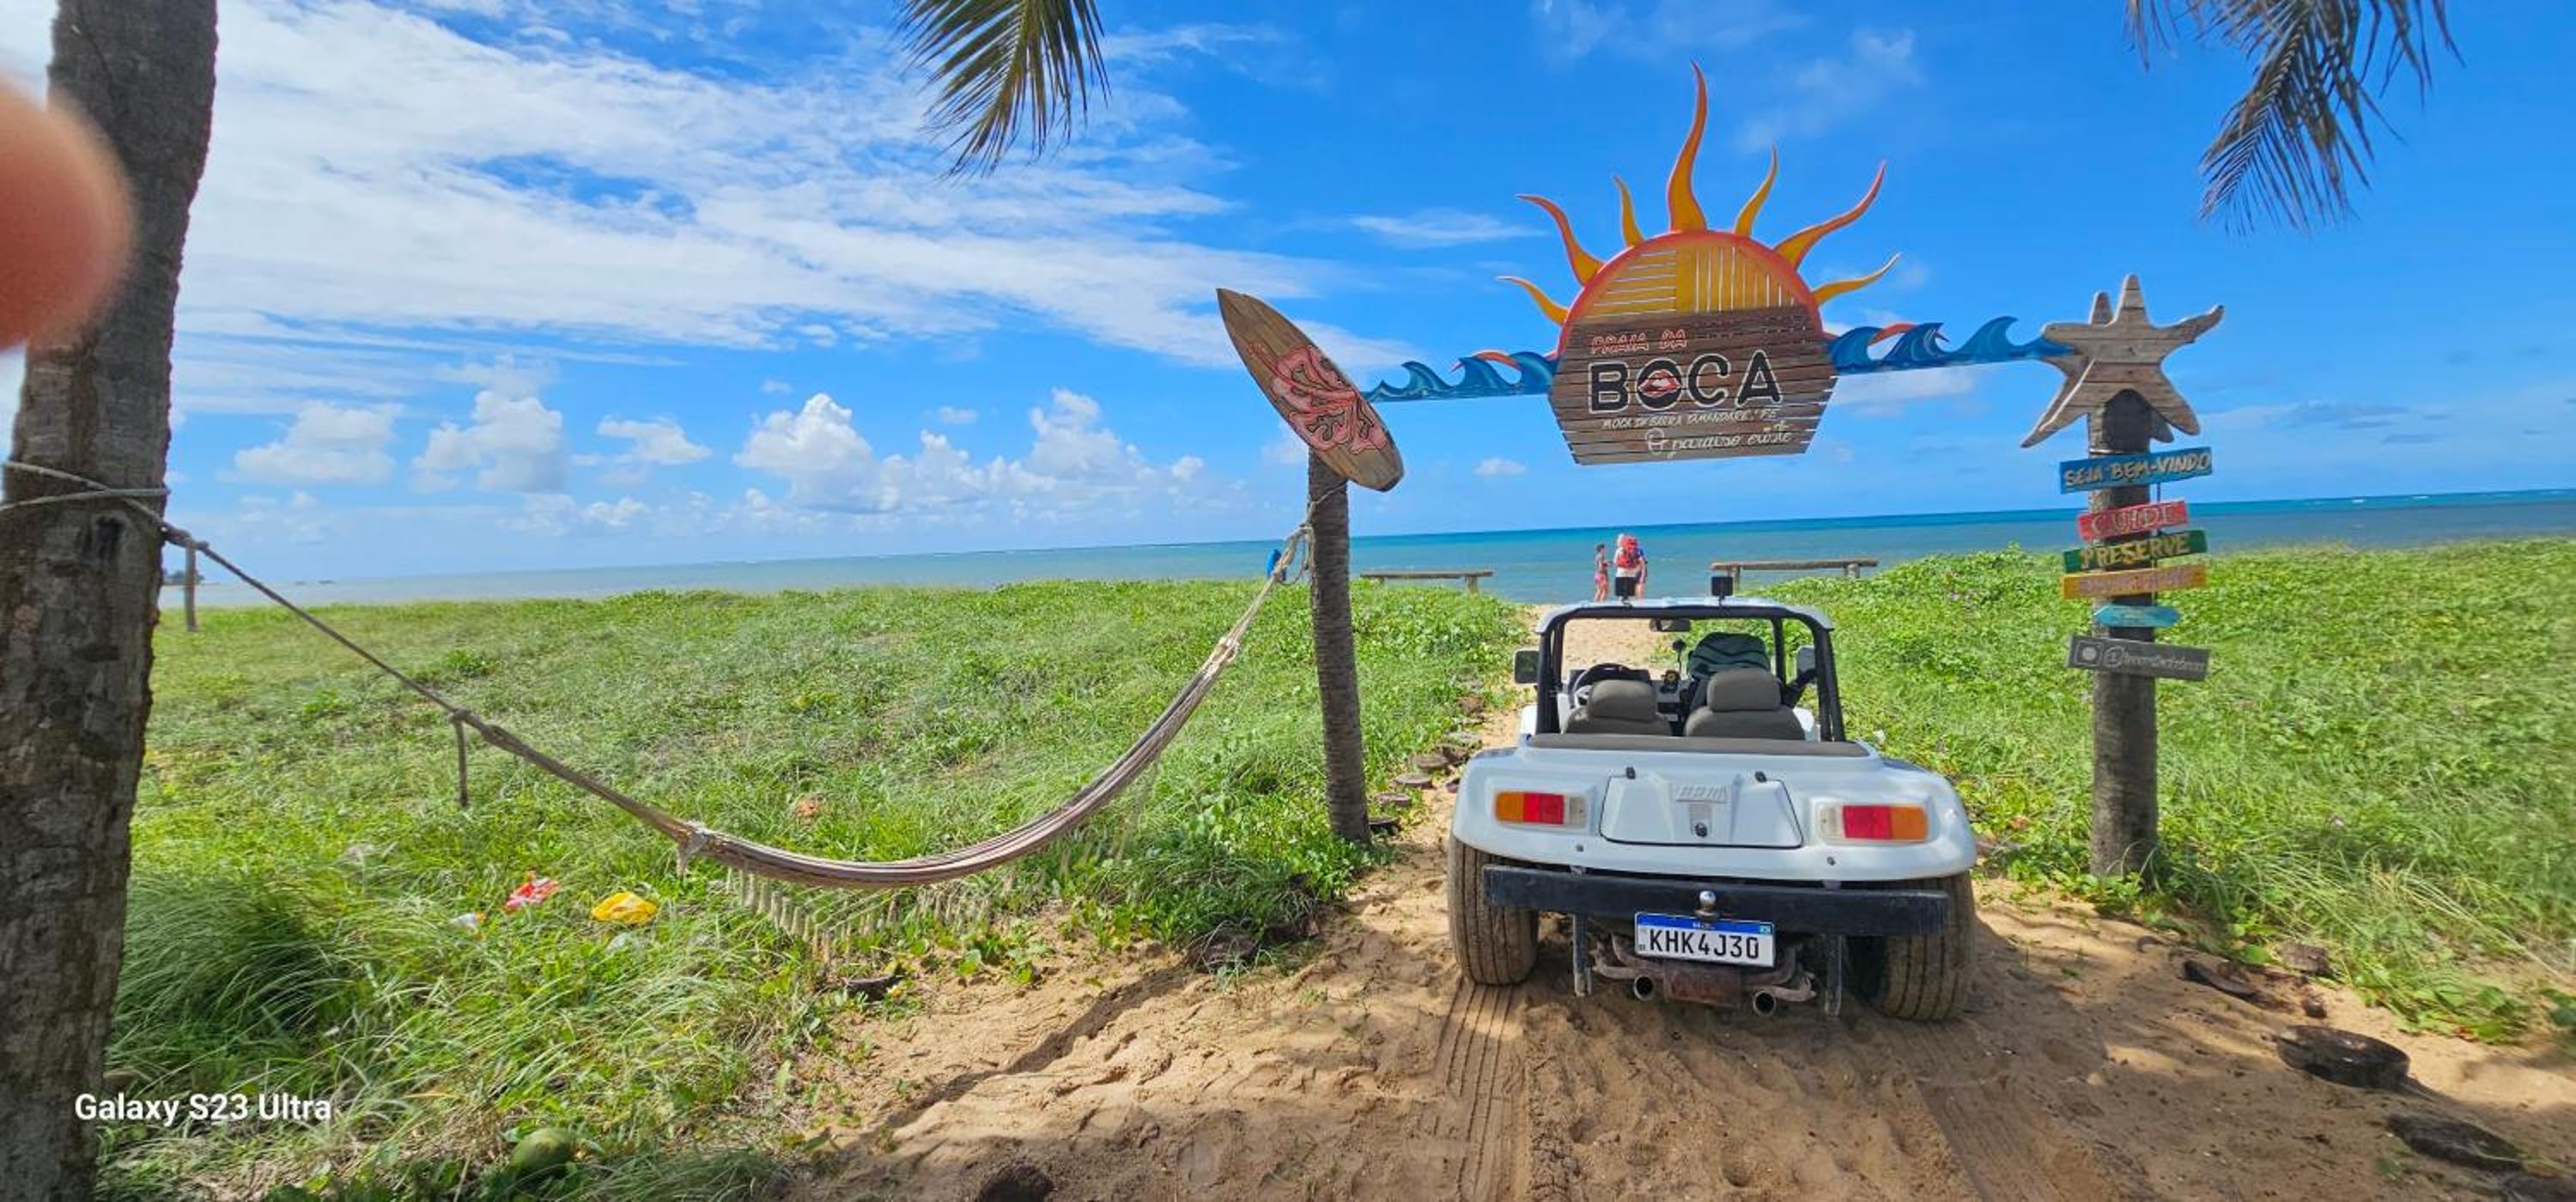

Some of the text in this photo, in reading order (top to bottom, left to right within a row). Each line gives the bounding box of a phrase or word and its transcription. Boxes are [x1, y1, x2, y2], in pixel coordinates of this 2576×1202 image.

[1591, 329, 1687, 355] PRAIA DA
[1589, 349, 1783, 414] BOCA
[2079, 531, 2190, 569] PRESERVE
[1649, 928, 1759, 960] KHK4J30
